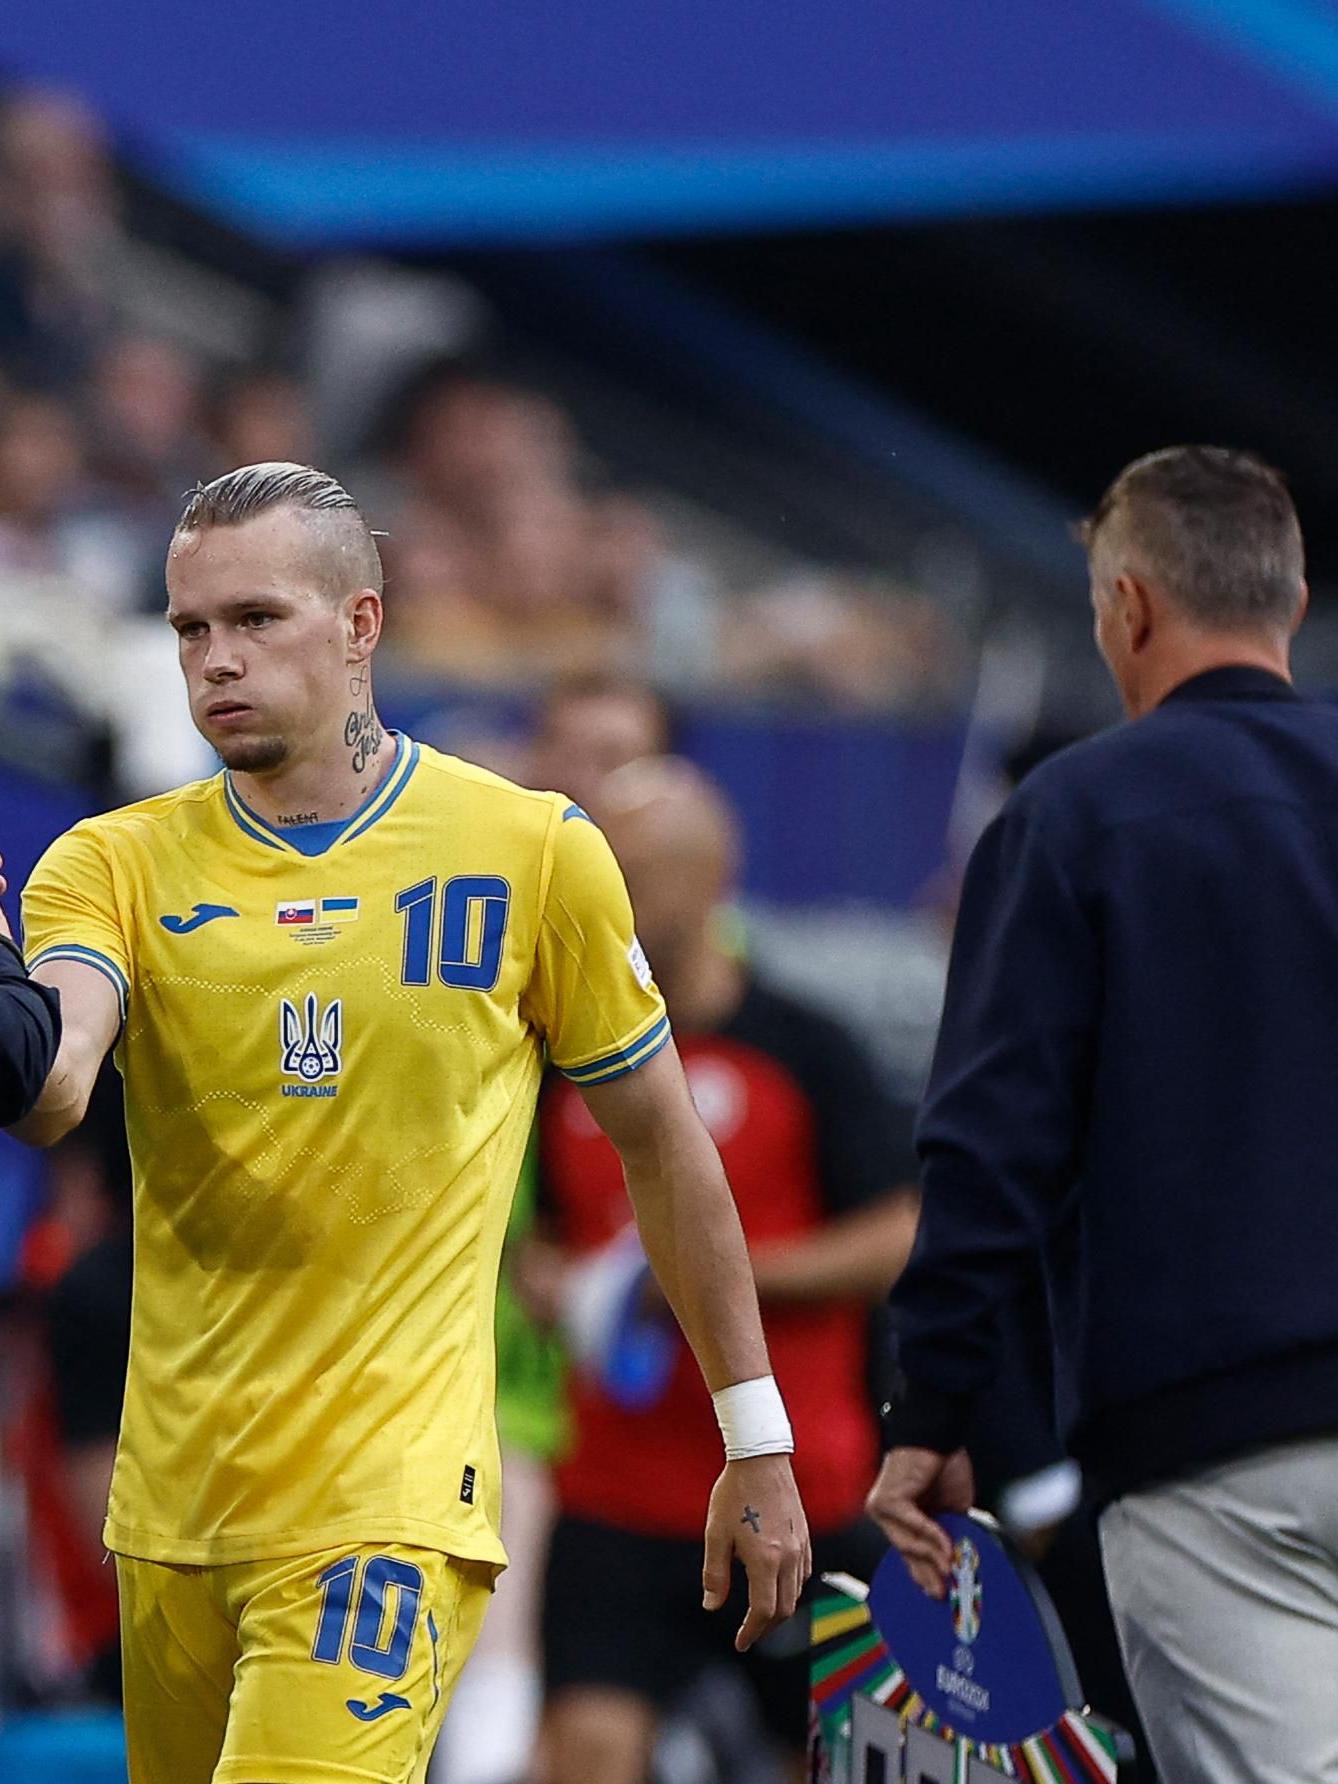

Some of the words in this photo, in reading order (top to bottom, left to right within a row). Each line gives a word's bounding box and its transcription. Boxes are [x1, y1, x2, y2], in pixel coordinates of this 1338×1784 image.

[395, 874, 511, 992] 10
[282, 1084, 337, 1097] UKRAINE
[311, 1555, 423, 1681] 10
